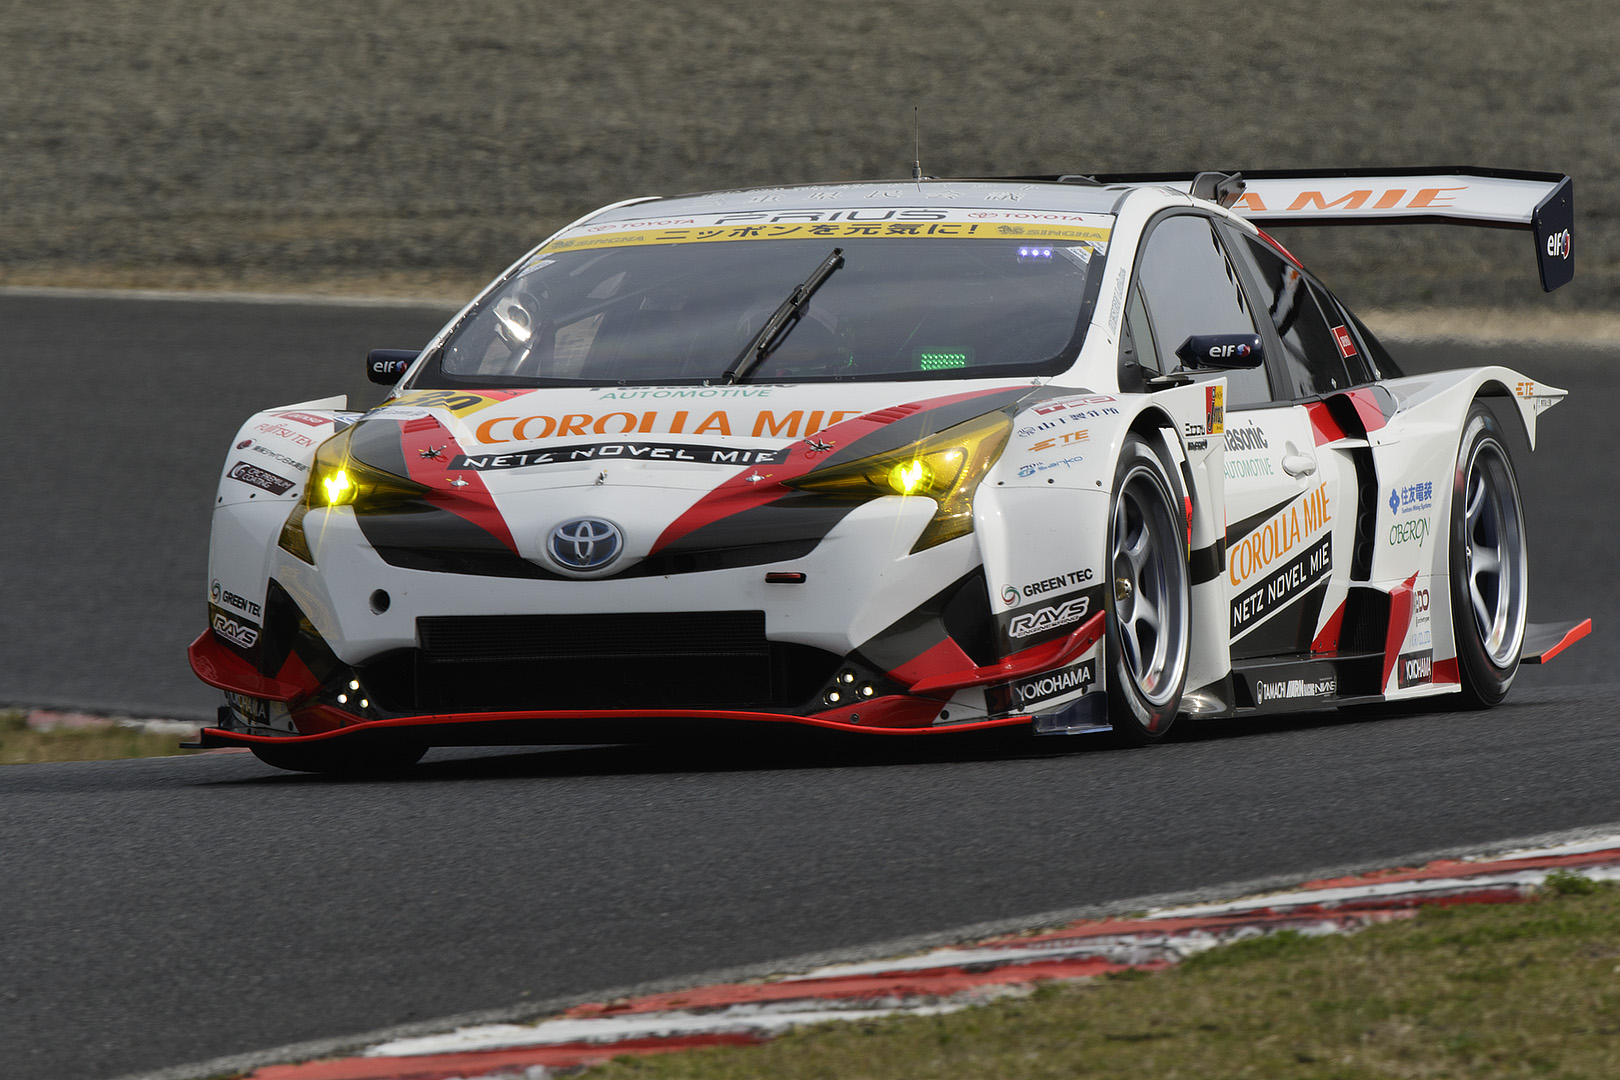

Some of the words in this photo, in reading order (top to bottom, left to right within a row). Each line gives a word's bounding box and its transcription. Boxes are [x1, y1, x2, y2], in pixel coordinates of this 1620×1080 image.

[1286, 186, 1469, 210] MIE
[621, 218, 694, 228] TOYOTA
[714, 209, 949, 225] PRIUS
[1003, 212, 1085, 222] TOYOTA
[1026, 229, 1103, 239] SINGHA
[1547, 232, 1562, 256] elf
[1209, 345, 1236, 358] elf
[373, 361, 396, 373] elf
[599, 389, 773, 400] AUTOMOTIVE
[254, 423, 295, 438] FUJITSU
[291, 434, 317, 448] TEN
[462, 452, 558, 468] NETZ
[571, 445, 695, 460] NOVEL
[711, 450, 779, 464] MIE
[1229, 506, 1301, 587] COROLLA
[1303, 481, 1332, 538] MIE
[1389, 517, 1431, 548] OBERON
[1023, 574, 1067, 597] GREEN
[1067, 568, 1094, 585] TEC
[1233, 588, 1264, 627] NETZ
[1268, 562, 1307, 605] NOVEL
[1310, 542, 1329, 576] MIE
[222, 590, 248, 611] GREEN
[1010, 598, 1089, 635] RAYS
[214, 614, 258, 647] RAYS
[1015, 666, 1091, 701] YOKOHAMA
